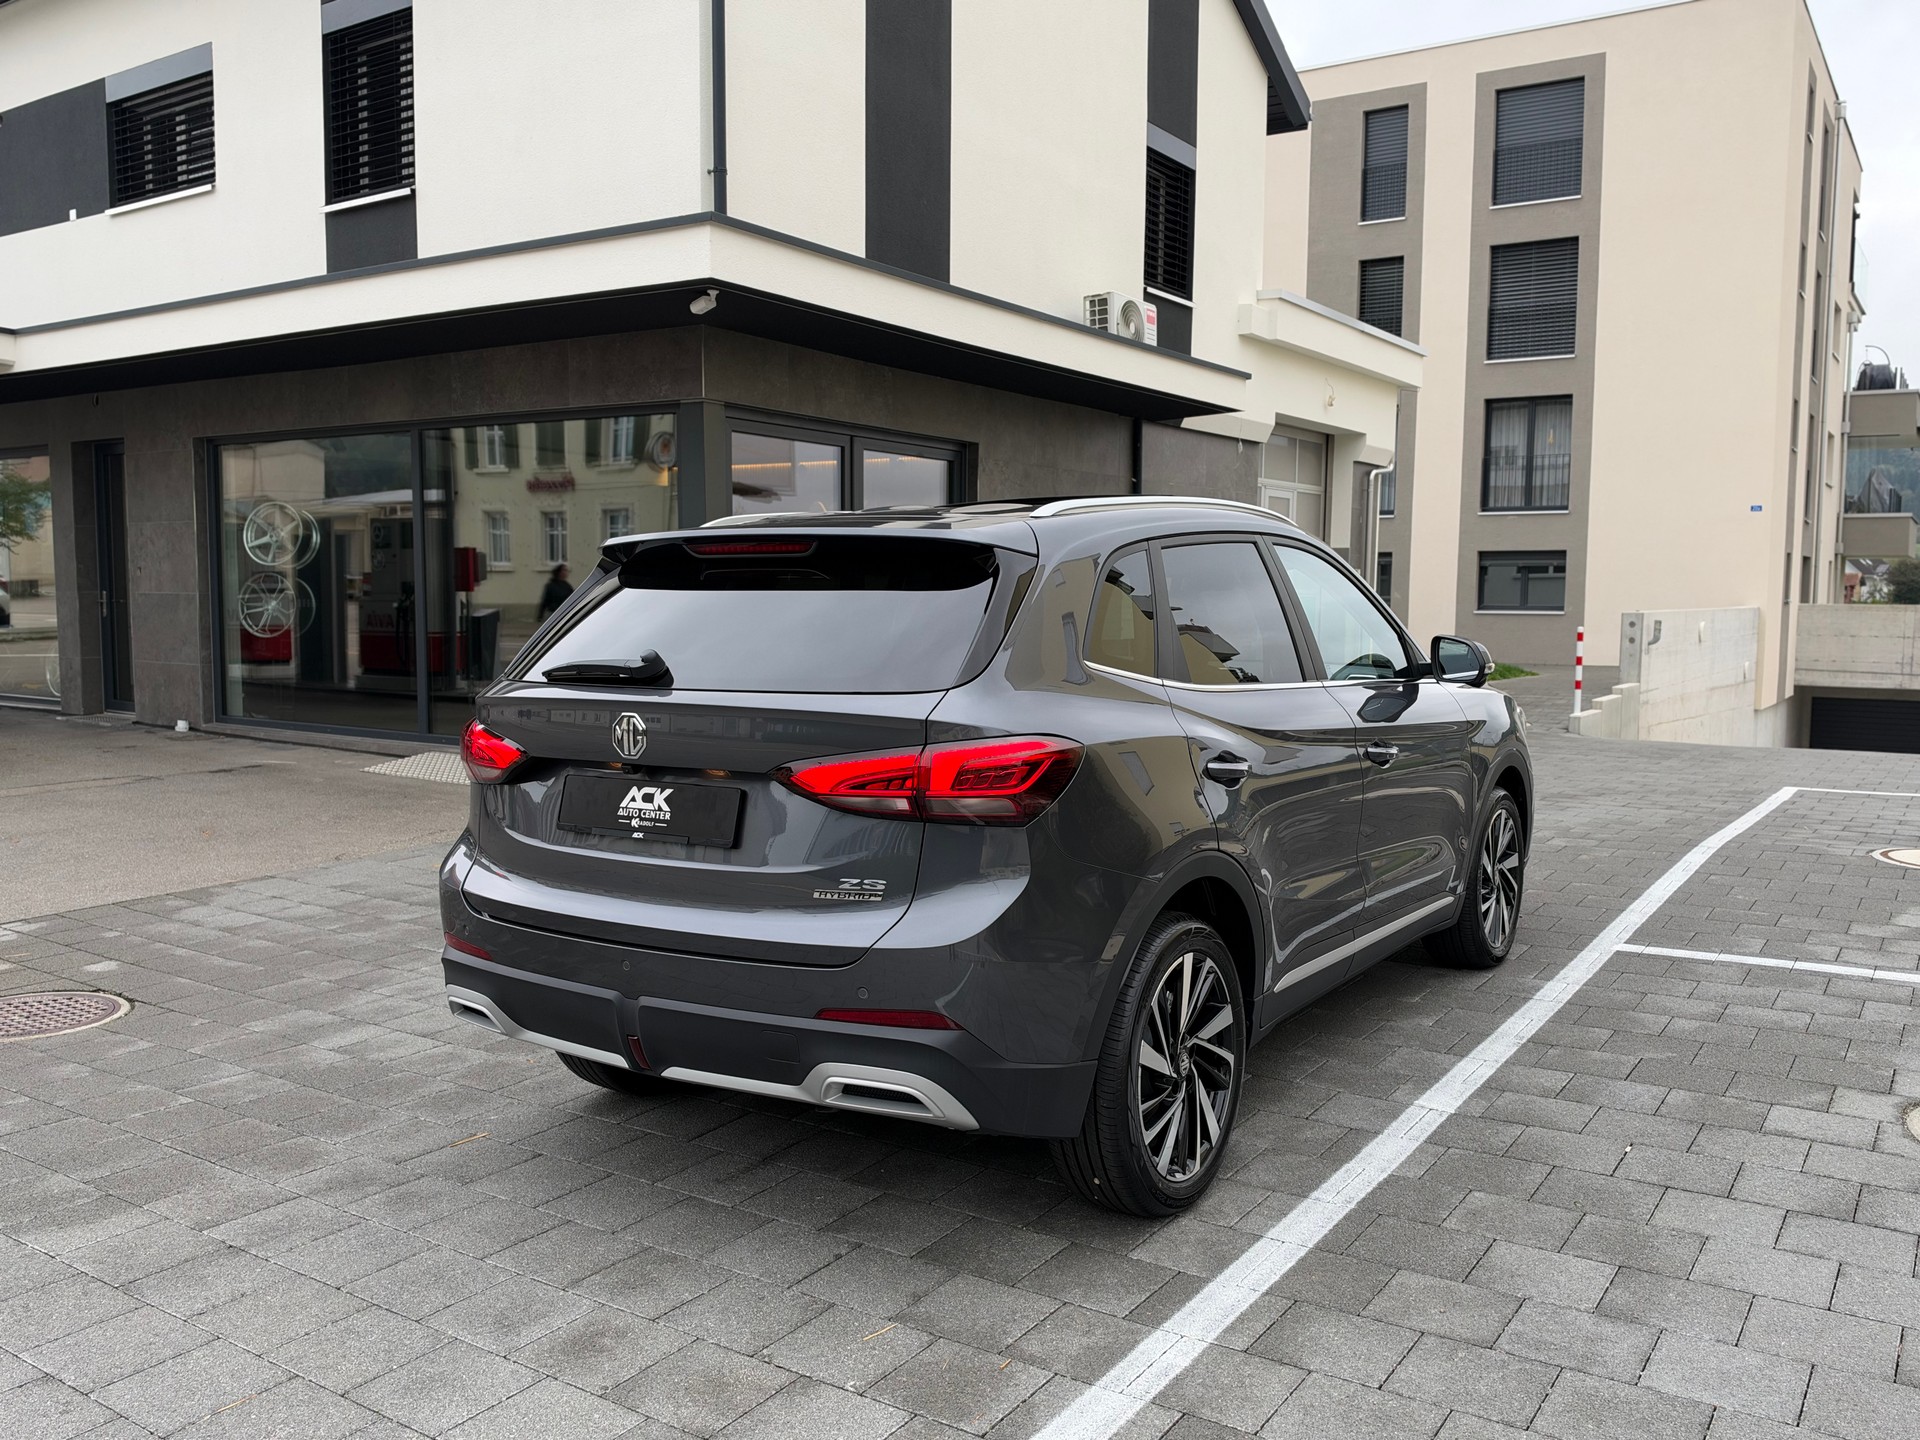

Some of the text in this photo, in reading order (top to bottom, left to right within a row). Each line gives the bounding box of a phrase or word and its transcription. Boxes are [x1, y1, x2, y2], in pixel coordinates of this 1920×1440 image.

[613, 714, 645, 757] MG
[619, 785, 674, 812] ACK
[617, 807, 671, 820] AUTO CENTER
[838, 878, 887, 890] ZS
